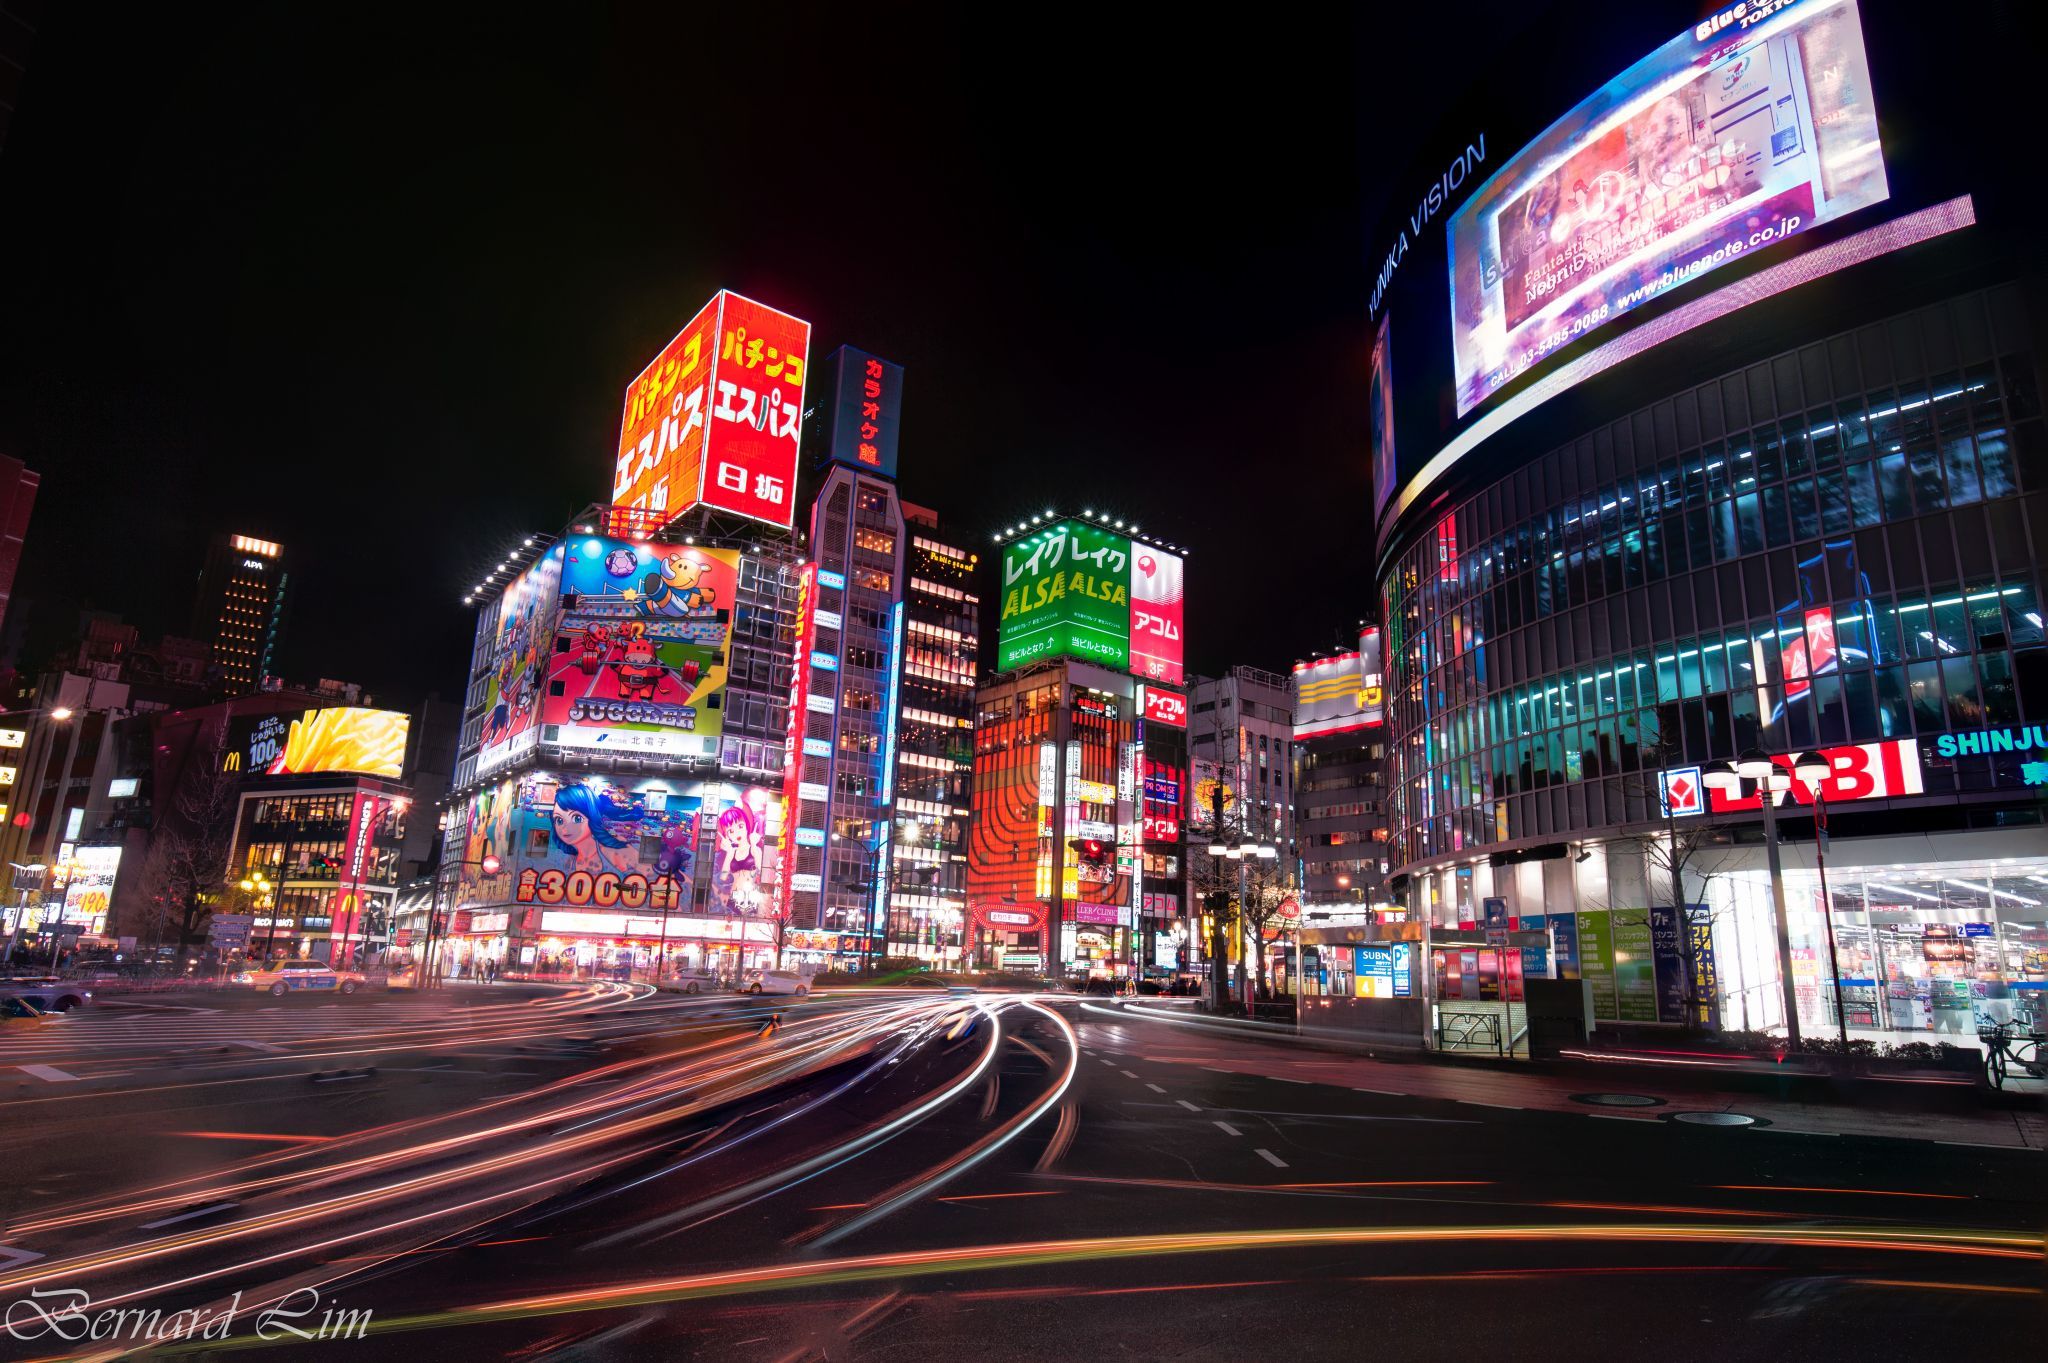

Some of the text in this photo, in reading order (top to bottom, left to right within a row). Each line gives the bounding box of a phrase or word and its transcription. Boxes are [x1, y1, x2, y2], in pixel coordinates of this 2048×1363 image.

[1695, 2, 1748, 42] Blue
[1368, 132, 1486, 322] YUNIKA VISION
[1490, 366, 1516, 388] CALL
[1520, 307, 1610, 369] 03-5485-0088
[1617, 214, 1801, 311] www.bluenote.co.jp
[721, 327, 804, 387] パチンコ
[627, 331, 702, 432] パチンコ
[713, 379, 799, 443] エスパス
[858, 359, 883, 467] カラオケ館
[612, 383, 704, 501] エスパス
[243, 559, 263, 570] APA
[1006, 533, 1066, 587] レイク
[1071, 536, 1126, 573] レイク
[1002, 571, 1066, 621] ALSA
[1068, 571, 1127, 607] ALSA
[1134, 611, 1180, 641] アコム
[1008, 642, 1044, 662] 当ビルとなり
[1071, 636, 1115, 656] 当ビルとなり
[1149, 663, 1165, 676] 3F
[568, 698, 697, 730] JUGGLER
[1147, 692, 1185, 715] アイフル
[1145, 780, 1176, 795] PROMISE
[1144, 817, 1177, 834] アイフル
[1143, 896, 1177, 911] アコム
[1653, 912, 1669, 926] 7F
[1578, 917, 1591, 929] 5F
[1957, 926, 1964, 935] 2
[1361, 980, 1370, 994] 4
